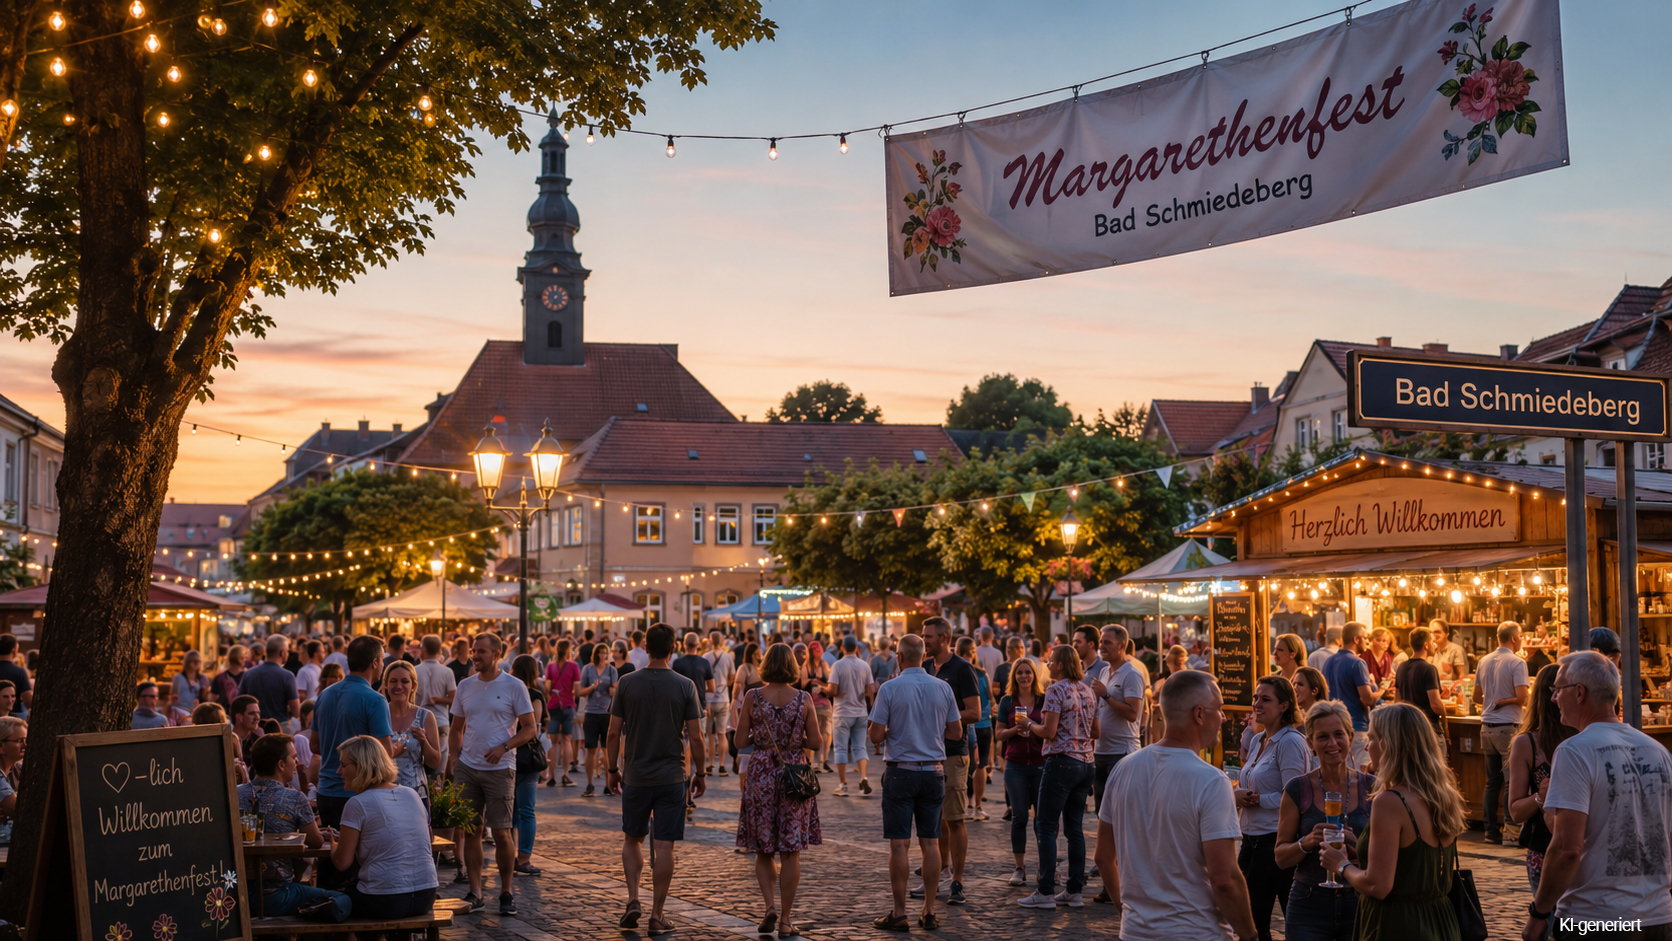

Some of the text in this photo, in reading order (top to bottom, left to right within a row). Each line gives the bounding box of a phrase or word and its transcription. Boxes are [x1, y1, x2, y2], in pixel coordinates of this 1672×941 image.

[1003, 66, 1406, 210] Margarethenfest
[1094, 174, 1313, 237] Bad Schmiedeberg
[1395, 378, 1641, 425] Bad Schmiedeberg
[1290, 499, 1507, 547] Herzlich Willkommen
[98, 802, 213, 835] Willkommen
[138, 843, 173, 861] zum
[94, 860, 225, 907] Margarethenfest!
